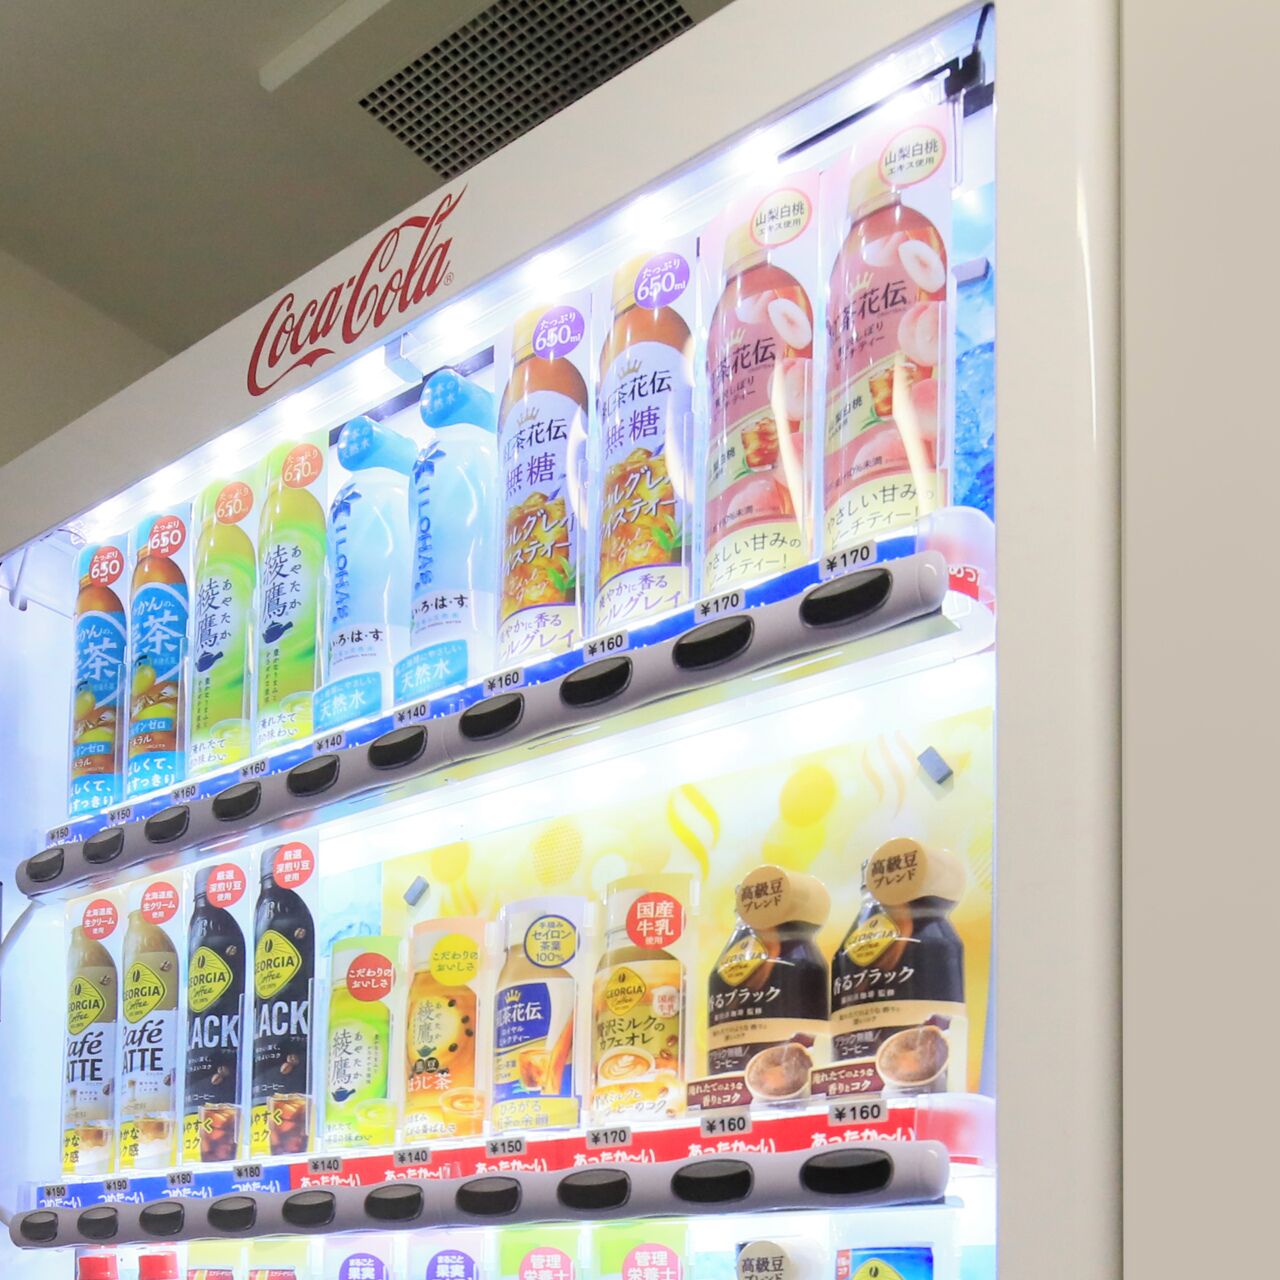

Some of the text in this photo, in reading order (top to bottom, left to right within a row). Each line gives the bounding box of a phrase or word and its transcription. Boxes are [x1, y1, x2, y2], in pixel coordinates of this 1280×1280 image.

[885, 140, 939, 166] 山梨白桃
[755, 200, 805, 227] 山梨白桃
[641, 258, 681, 279] たっぷり
[247, 183, 468, 396] Coca-Cola
[540, 312, 577, 330] たっぷり
[825, 545, 871, 572] ¥170
[700, 592, 740, 617] ¥170
[588, 634, 624, 656] ¥160
[487, 671, 520, 691] ¥160
[397, 704, 427, 722] ¥140
[316, 734, 342, 751] ¥140
[242, 761, 266, 777] ¥160
[174, 785, 196, 799] ¥160
[109, 808, 131, 822] ¥150
[49, 827, 69, 841] ¥150
[871, 850, 918, 875] 高級豆
[874, 869, 917, 888] ブレンド
[740, 877, 784, 899] 高級豆
[636, 900, 675, 919] 国産
[743, 895, 782, 913] ブレンド
[531, 928, 572, 941] セイロン
[636, 919, 675, 937] 牛乳
[253, 1001, 309, 1040] ACK
[834, 1104, 881, 1122] ¥160
[706, 1116, 746, 1133] ¥160
[489, 1139, 523, 1154] ¥150
[590, 1130, 626, 1145] ¥170
[311, 1159, 339, 1172] ¥140
[398, 1150, 428, 1164] ¥140
[170, 1172, 192, 1185] ¥180
[236, 1165, 261, 1179] ¥180
[46, 1185, 66, 1198] ¥190
[106, 1178, 128, 1191] ¥190
[530, 1254, 562, 1269] 管理
[634, 1251, 668, 1267] 管理
[741, 1255, 784, 1274] 高級豆
